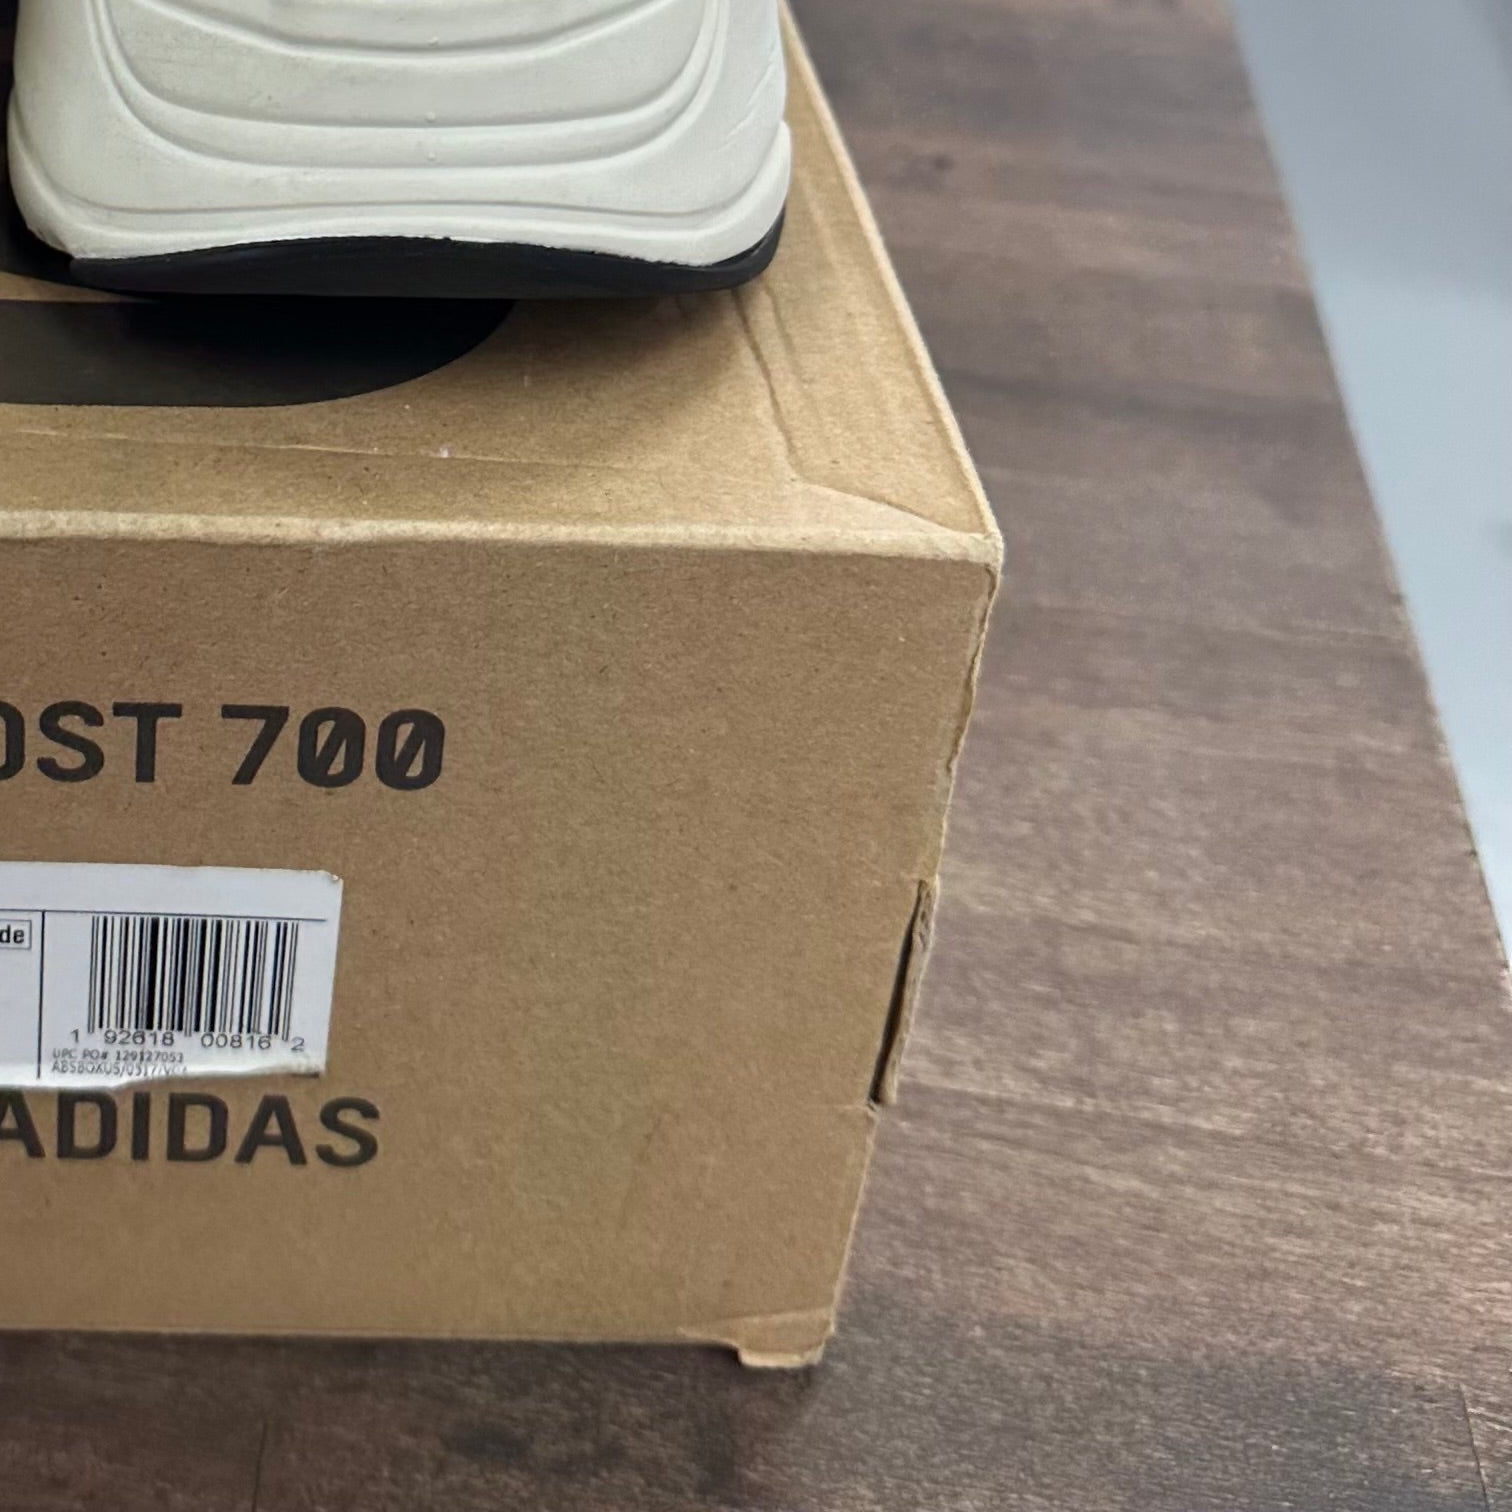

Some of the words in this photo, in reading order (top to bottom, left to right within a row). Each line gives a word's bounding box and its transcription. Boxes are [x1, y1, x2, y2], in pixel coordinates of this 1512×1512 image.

[221, 703, 446, 790] 700
[70, 1029, 81, 1043] 1
[200, 1032, 272, 1050] 00816
[291, 1036, 305, 1052] 2
[52, 1048, 77, 1059] UPC
